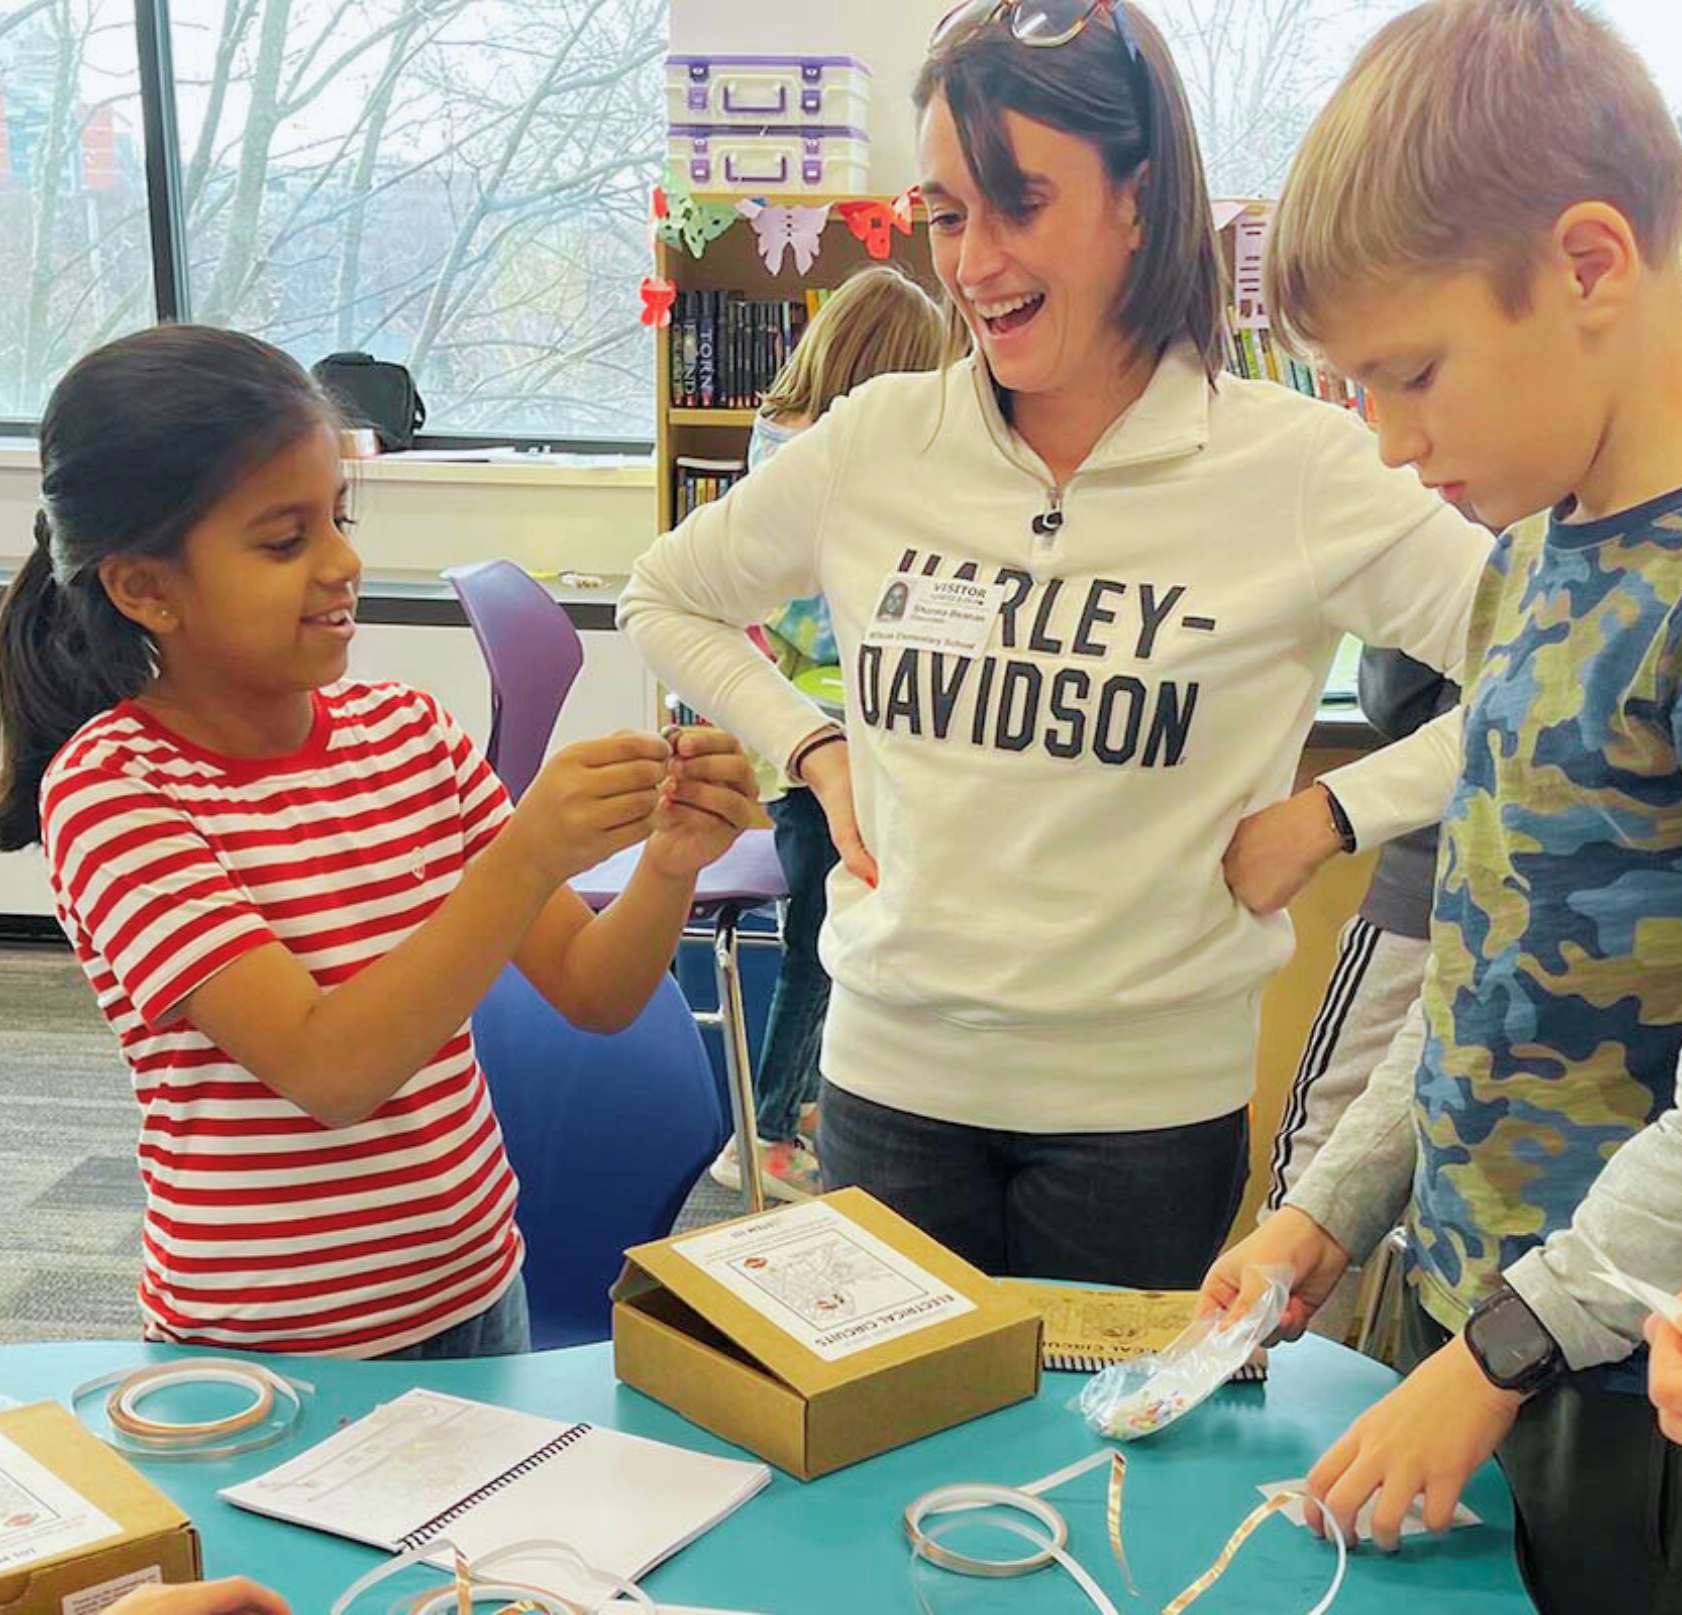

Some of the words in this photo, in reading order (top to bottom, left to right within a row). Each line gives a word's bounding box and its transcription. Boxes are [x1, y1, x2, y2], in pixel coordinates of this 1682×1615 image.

[700, 328, 714, 390] TORN
[933, 583, 987, 599] VISITOR
[858, 644, 1199, 768] DAVIDSON
[877, 1293, 956, 1323] ELECTRICAL
[814, 1320, 878, 1346] CIRCUITS
